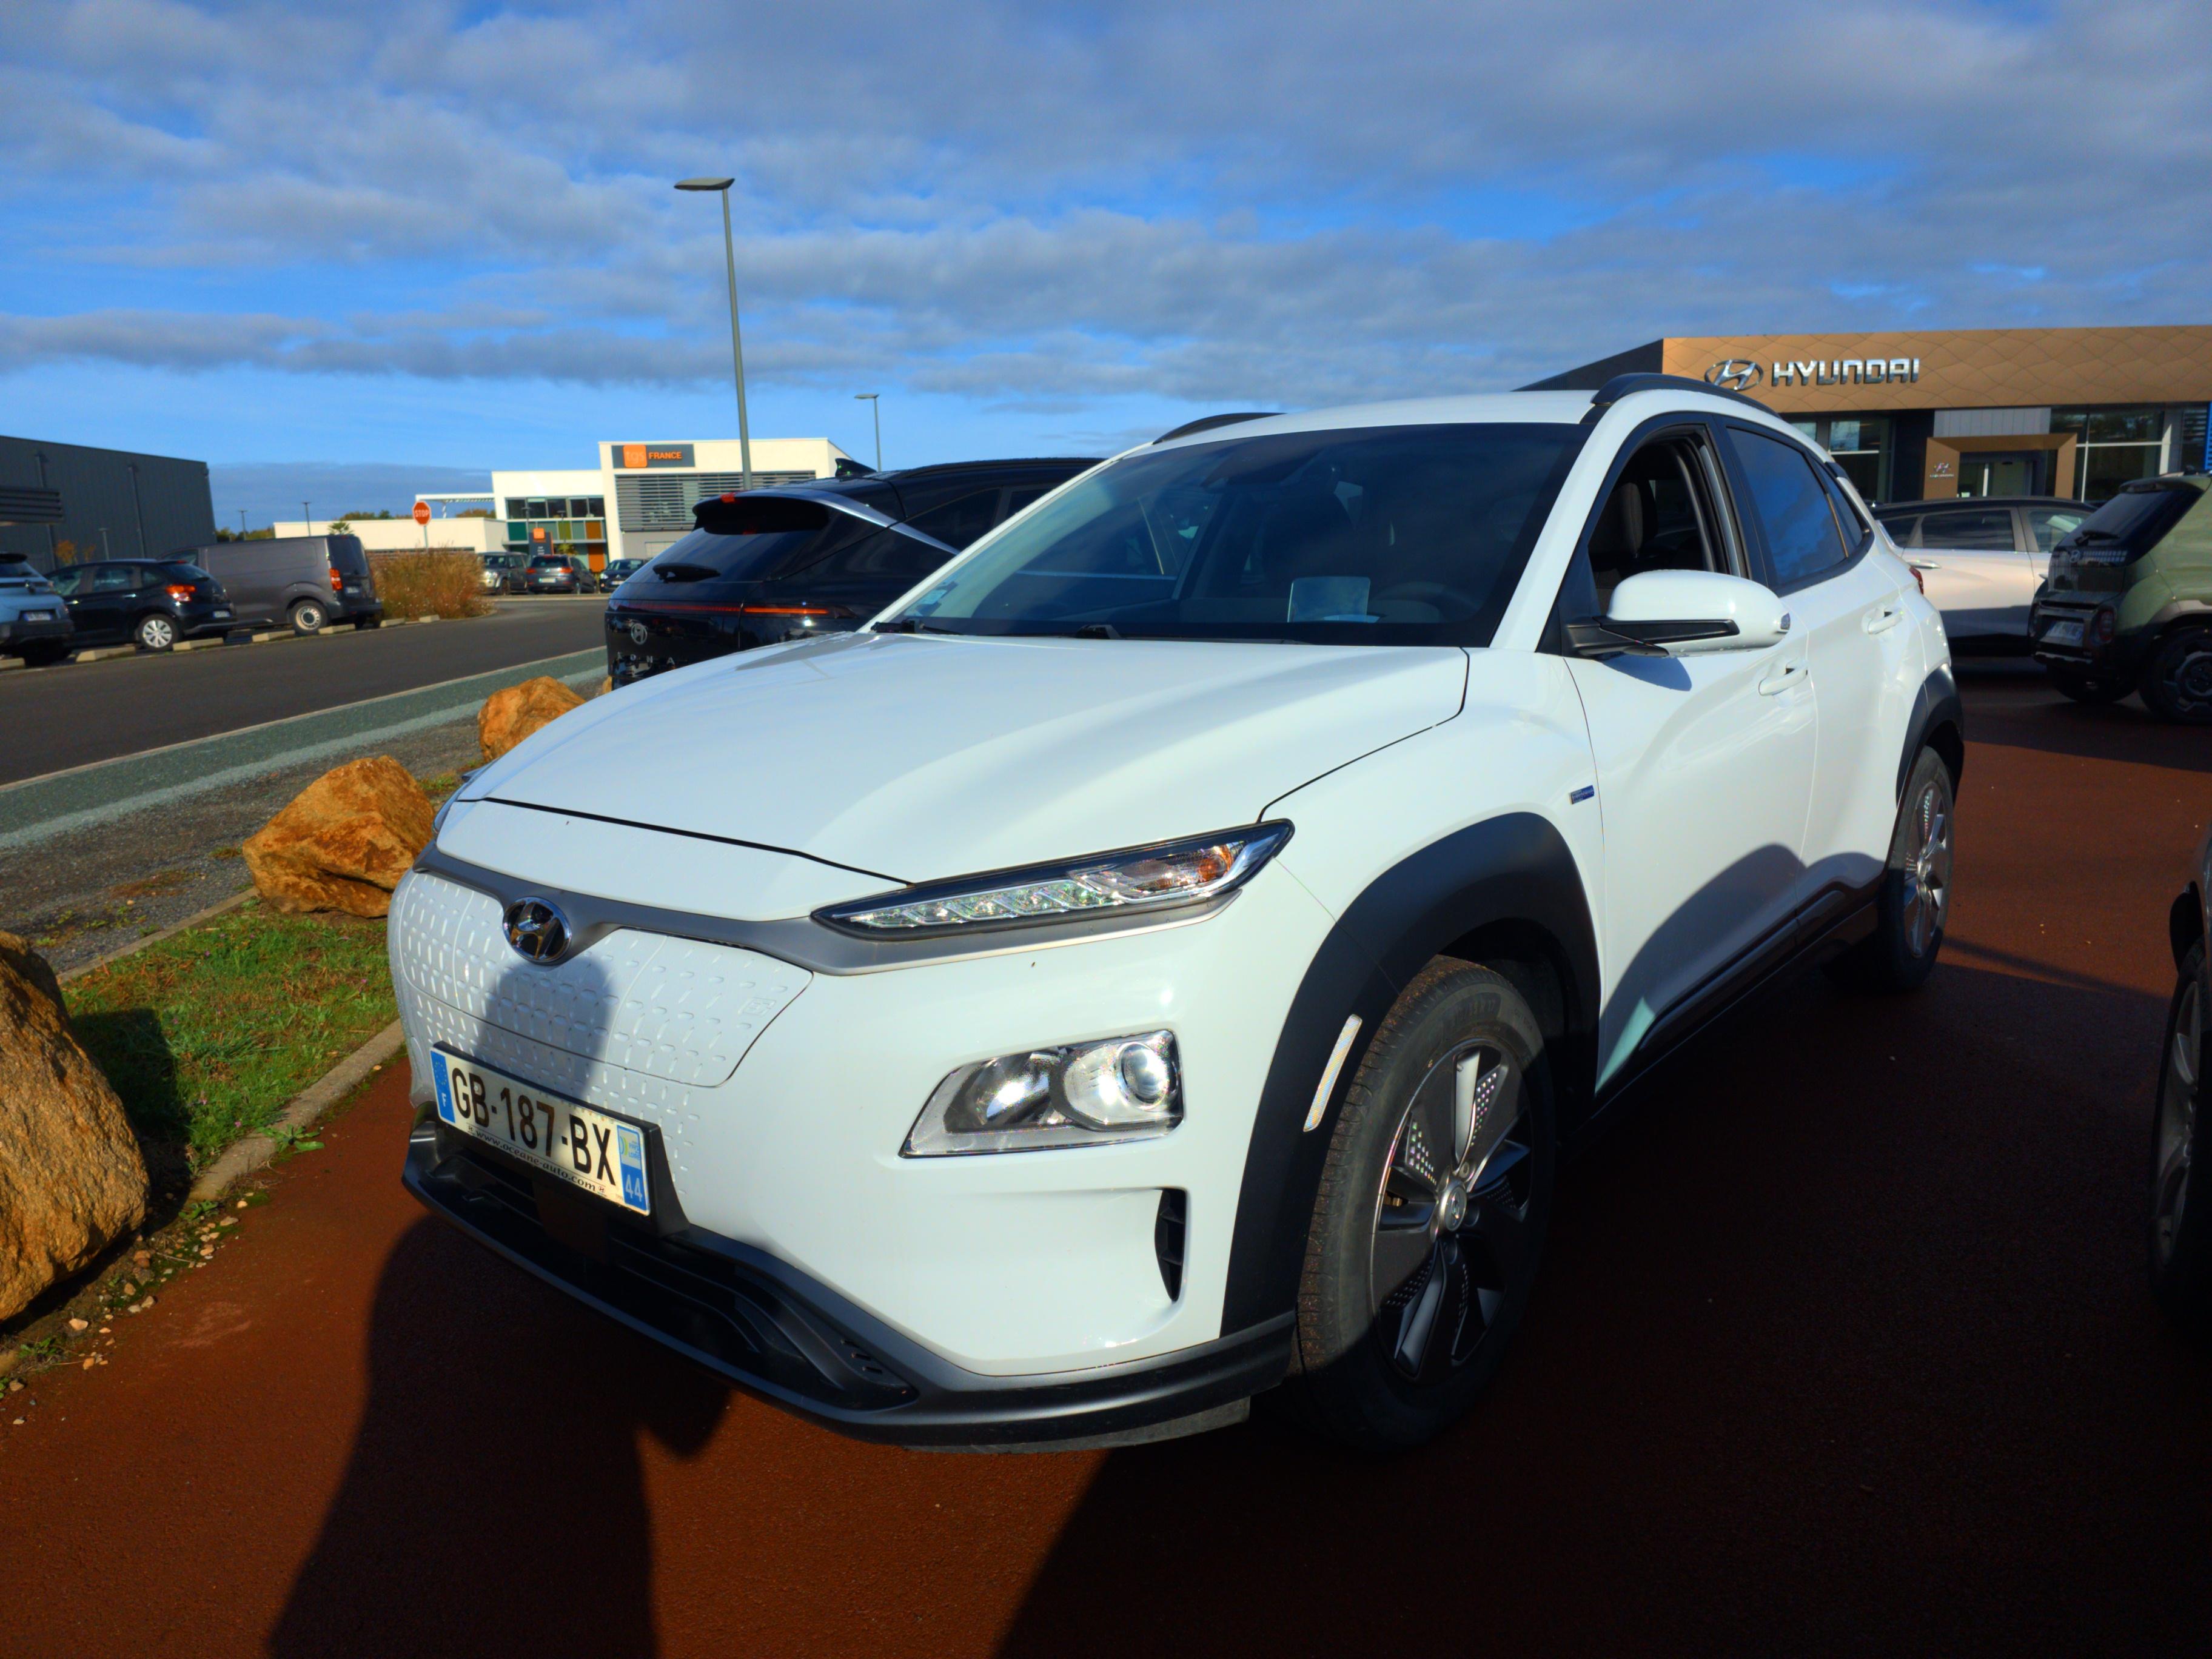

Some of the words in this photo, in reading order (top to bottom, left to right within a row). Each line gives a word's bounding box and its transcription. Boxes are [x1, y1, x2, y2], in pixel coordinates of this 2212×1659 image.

[1772, 358, 1920, 387] HYUNDAI
[625, 451, 645, 464] tgs
[648, 451, 683, 460] FRANCE
[441, 1092, 447, 1107] F
[452, 1067, 617, 1187] GB-187-BX
[476, 1129, 596, 1192] www.oceane-auto.com
[625, 1174, 643, 1202] 44
